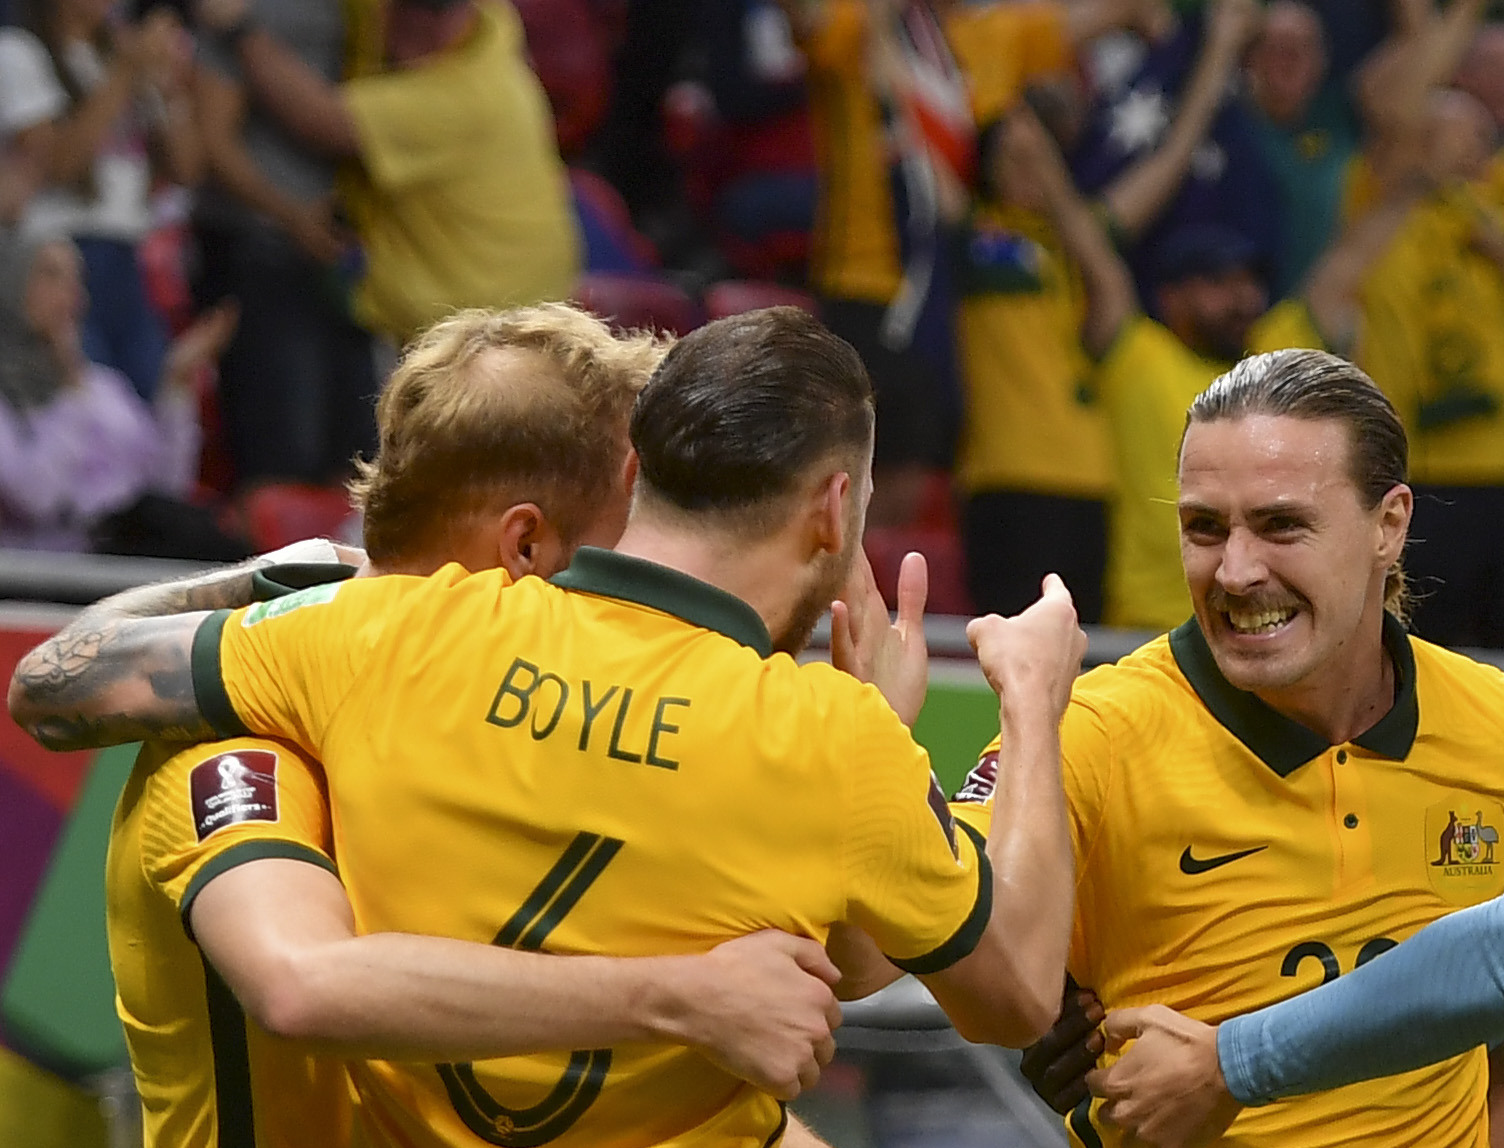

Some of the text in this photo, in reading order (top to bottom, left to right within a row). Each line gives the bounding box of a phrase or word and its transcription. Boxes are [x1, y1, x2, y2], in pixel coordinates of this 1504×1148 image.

[484, 657, 691, 771] BOYLE
[1443, 866, 1493, 877] AUSTRALIA
[434, 831, 626, 1148] 6
[1280, 937, 1399, 986] 2
